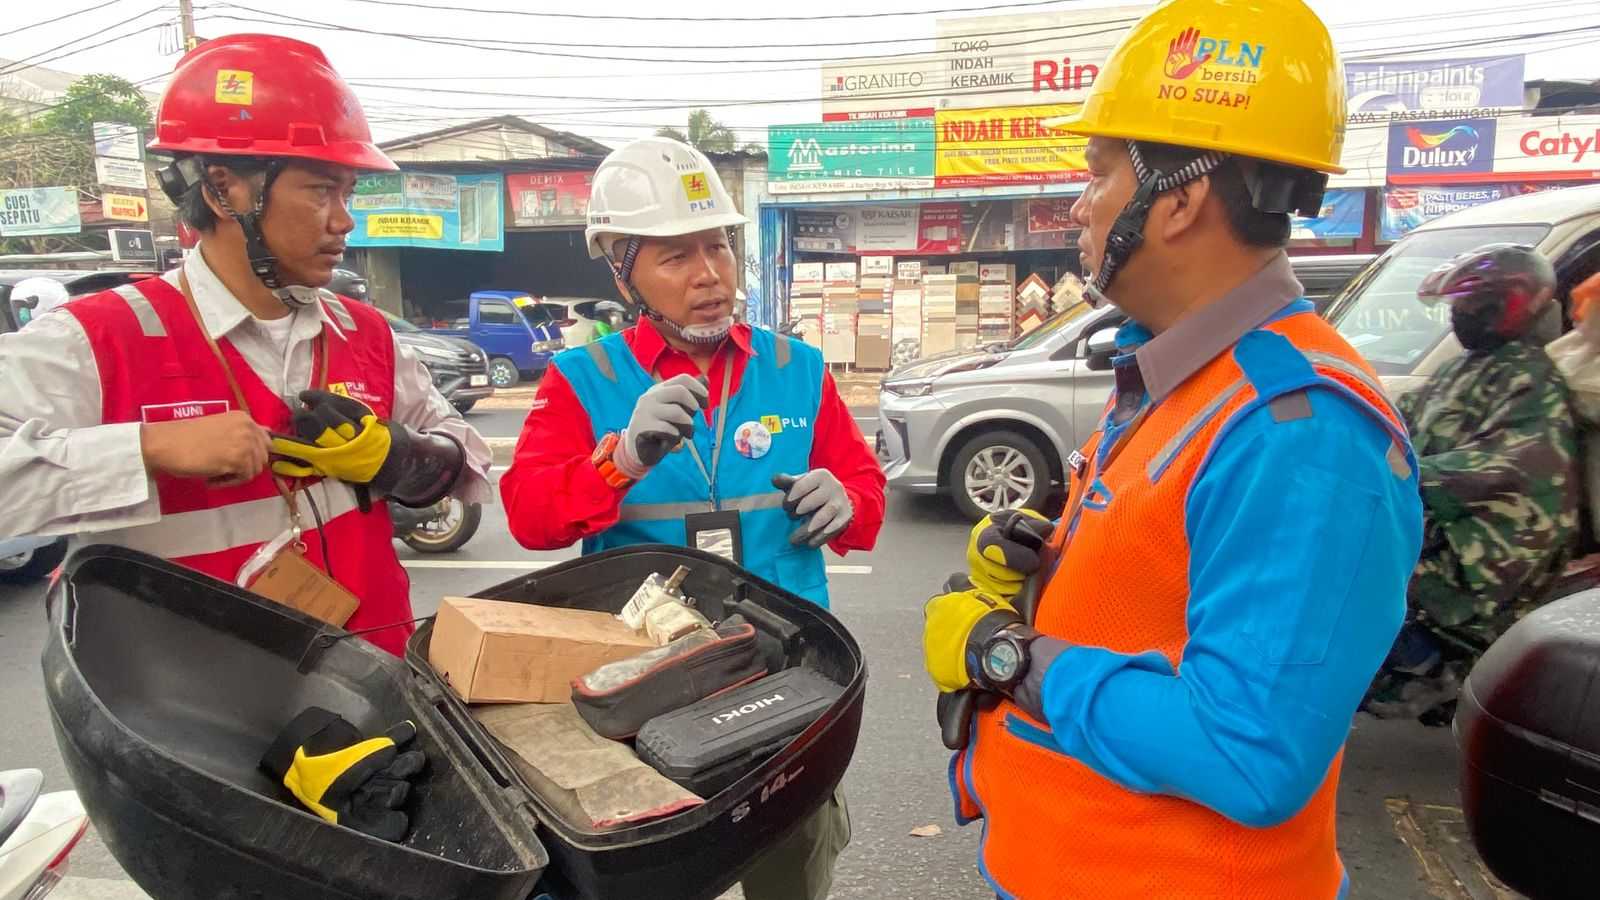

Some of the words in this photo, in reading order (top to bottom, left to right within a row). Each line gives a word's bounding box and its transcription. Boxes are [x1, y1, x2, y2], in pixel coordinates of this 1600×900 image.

[953, 40, 990, 53] TOKO
[1194, 38, 1265, 68] PLN
[951, 57, 994, 71] INDAH
[845, 71, 923, 91] GRANITO
[951, 73, 1015, 88] KERAMIK
[1201, 68, 1257, 84] bersih
[1158, 84, 1188, 101] NO
[1193, 87, 1251, 110] SUAP!
[1346, 112, 1376, 124] AYA
[1391, 111, 1438, 122] PASAR
[1442, 108, 1503, 120] MINGGU
[943, 118, 1004, 143] INDAH
[1403, 145, 1477, 168] Dulux
[878, 166, 916, 176] TILE
[5, 195, 30, 210] CUCI
[690, 200, 716, 212] PLN
[0, 209, 40, 225] SEPATU
[782, 417, 808, 428] PLN
[712, 694, 785, 725] HIOKI
